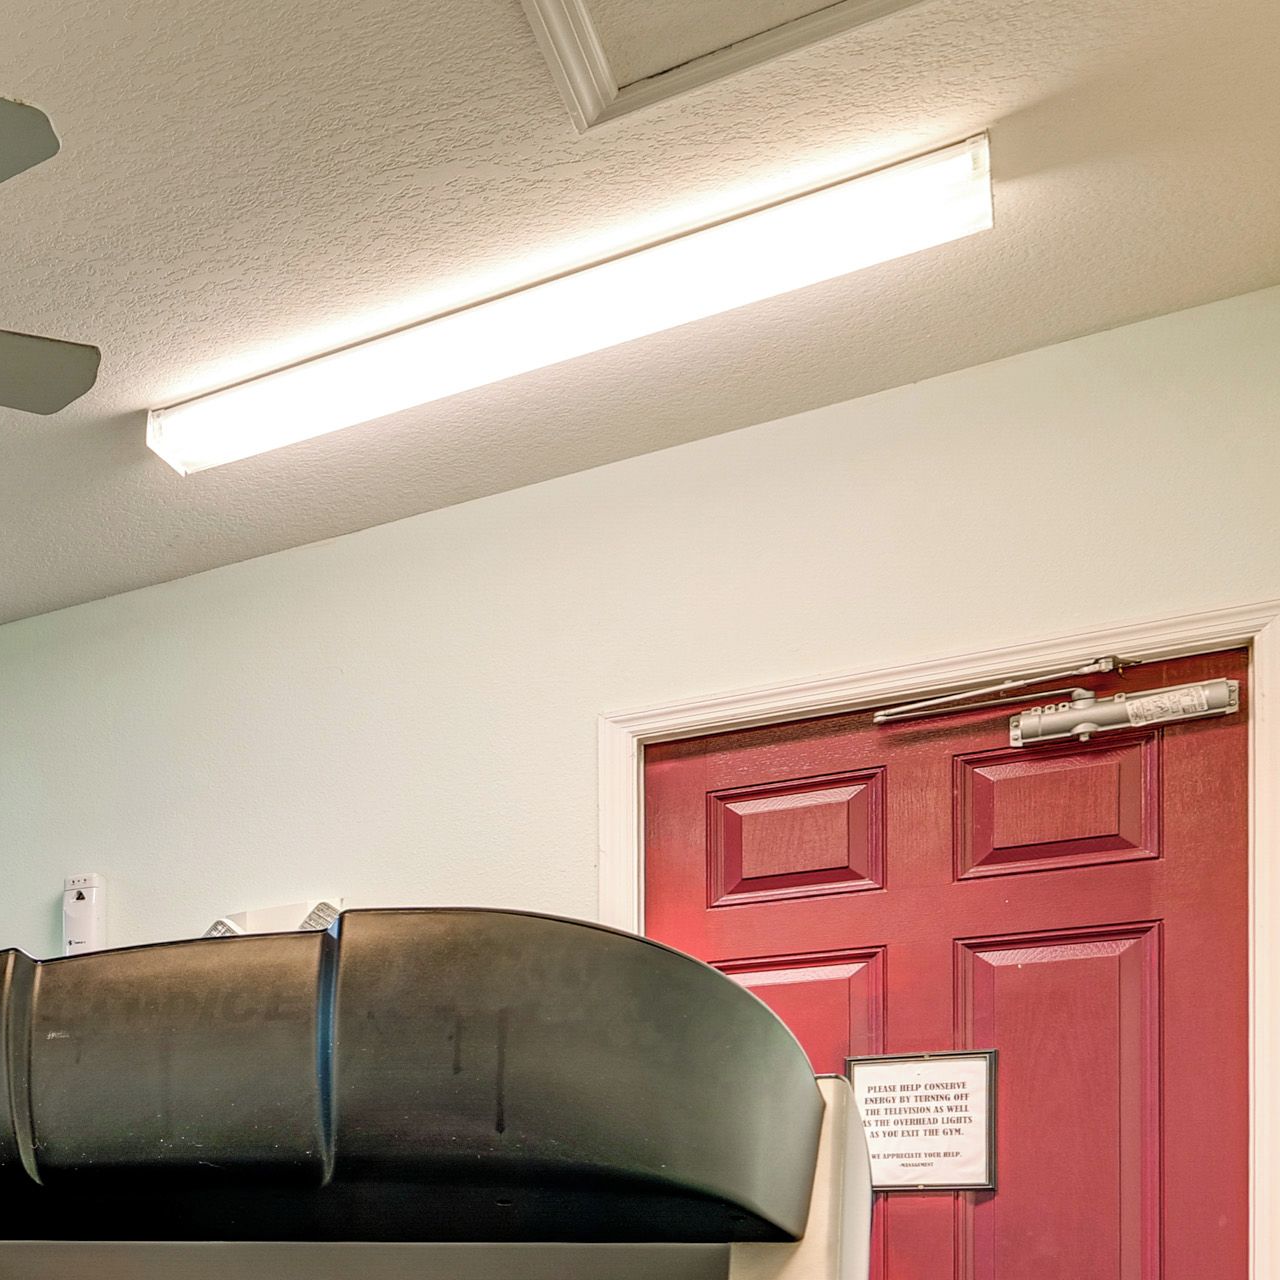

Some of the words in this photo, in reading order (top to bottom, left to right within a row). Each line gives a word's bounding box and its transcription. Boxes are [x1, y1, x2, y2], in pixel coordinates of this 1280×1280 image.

[867, 1085, 897, 1094] PLEASE
[900, 1083, 922, 1092] HELP
[924, 1081, 967, 1091] CONSERVE
[864, 1096, 897, 1105] ENERGY
[899, 1095, 910, 1104] BY
[914, 1094, 951, 1103] TURNING
[953, 1093, 969, 1101] OFF
[864, 1108, 880, 1116] THE
[884, 1106, 931, 1116] TELEVISION
[933, 1105, 944, 1114] AS
[946, 1104, 969, 1113] WELL
[862, 1119, 872, 1128] AS
[874, 1119, 890, 1127] THE
[893, 1117, 939, 1127] OVERHEAD
[941, 1115, 973, 1125] LIGHTS
[869, 1130, 880, 1138] AS
[882, 1129, 899, 1138] YOU
[901, 1129, 921, 1138] EXIT
[923, 1128, 939, 1137] THE
[942, 1127, 965, 1136] GYM.
[882, 1152, 922, 1160] APPRECIATE
[924, 1151, 942, 1159] YOUR
